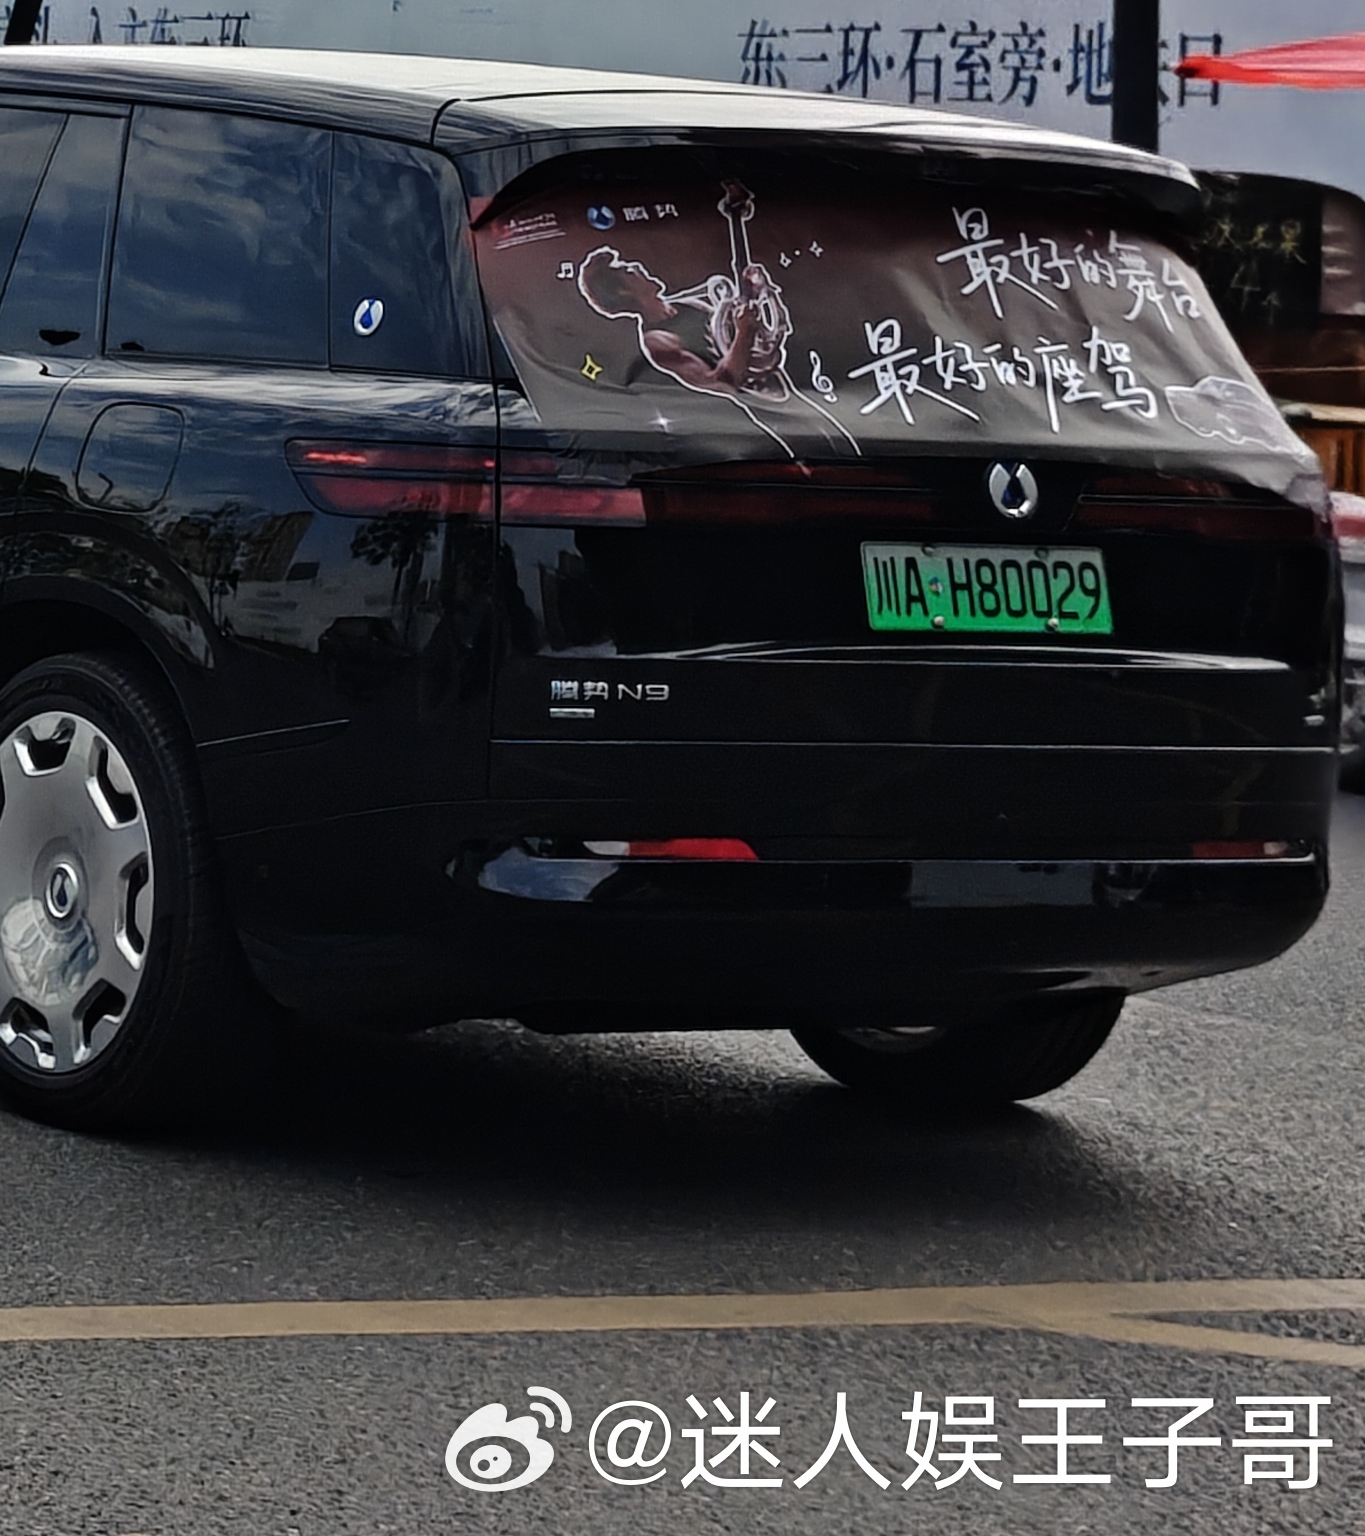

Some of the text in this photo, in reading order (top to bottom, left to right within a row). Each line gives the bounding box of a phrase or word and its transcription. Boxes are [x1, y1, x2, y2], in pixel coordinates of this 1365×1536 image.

[936, 206, 1203, 334] 最好的舞台
[847, 317, 1159, 434] 最好的座驾
